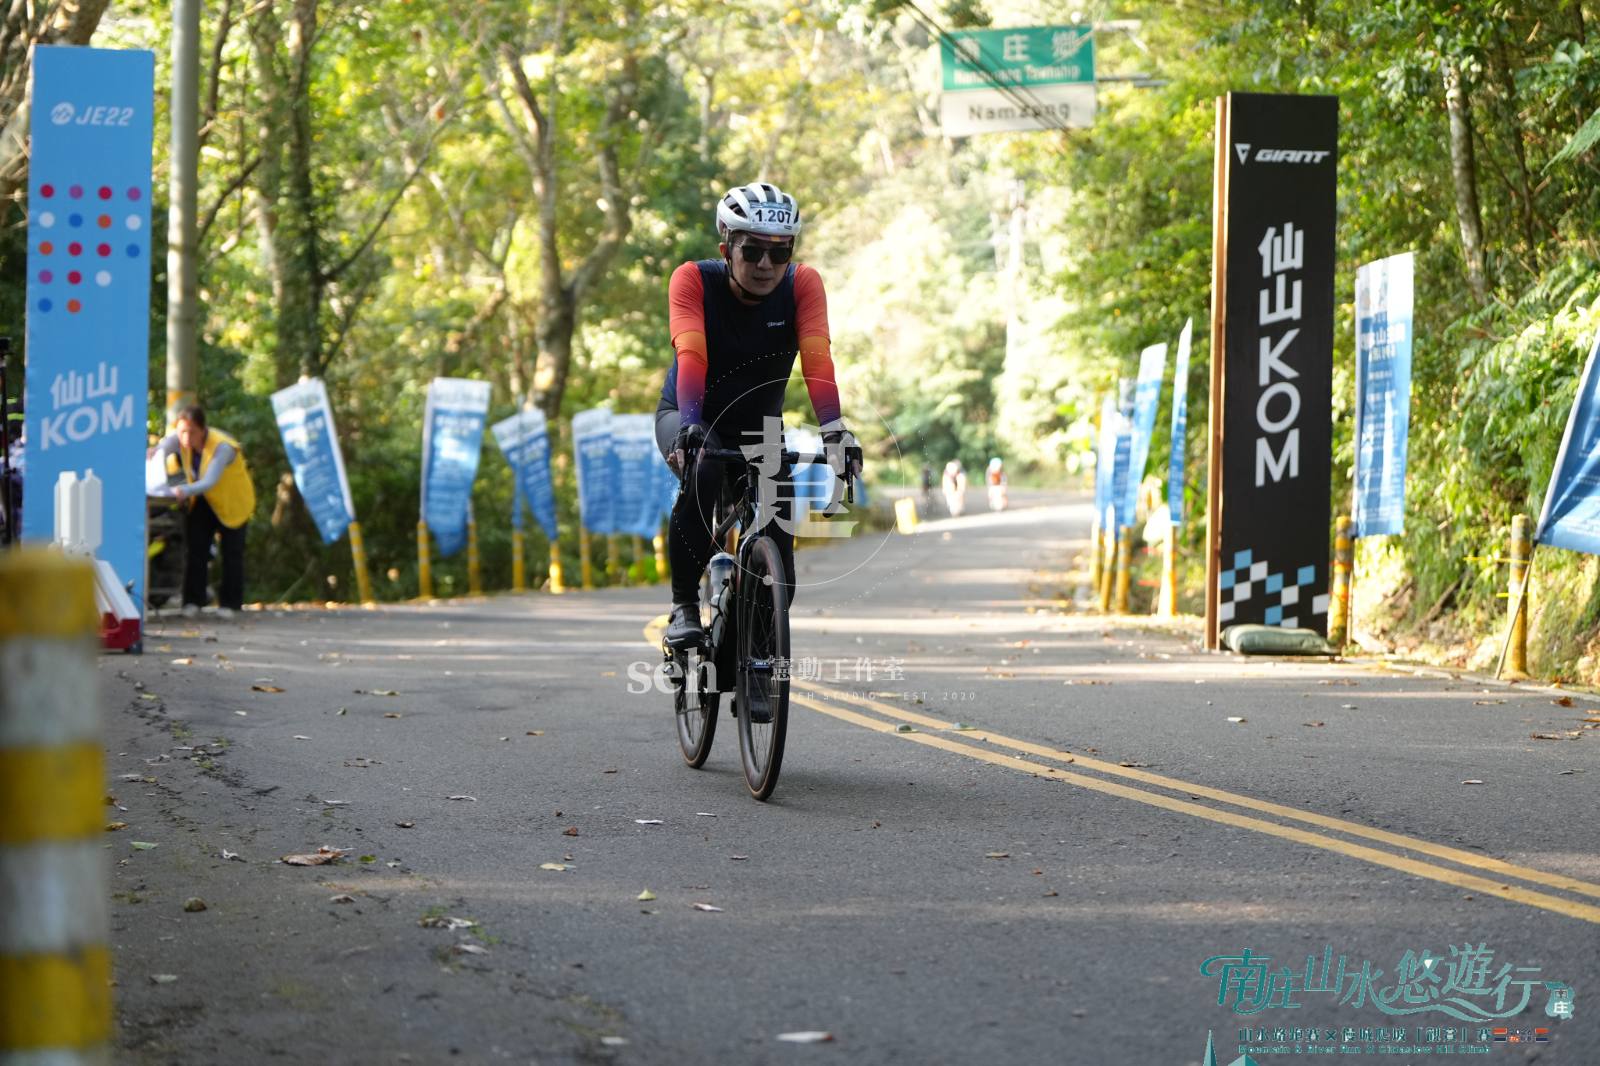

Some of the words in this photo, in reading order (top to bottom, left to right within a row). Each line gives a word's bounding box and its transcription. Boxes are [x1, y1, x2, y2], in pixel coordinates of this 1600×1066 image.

[75, 106, 134, 126] JE22
[1255, 149, 1330, 163] GIANT
[50, 361, 118, 411] 仙山
[41, 394, 134, 451] KOM
